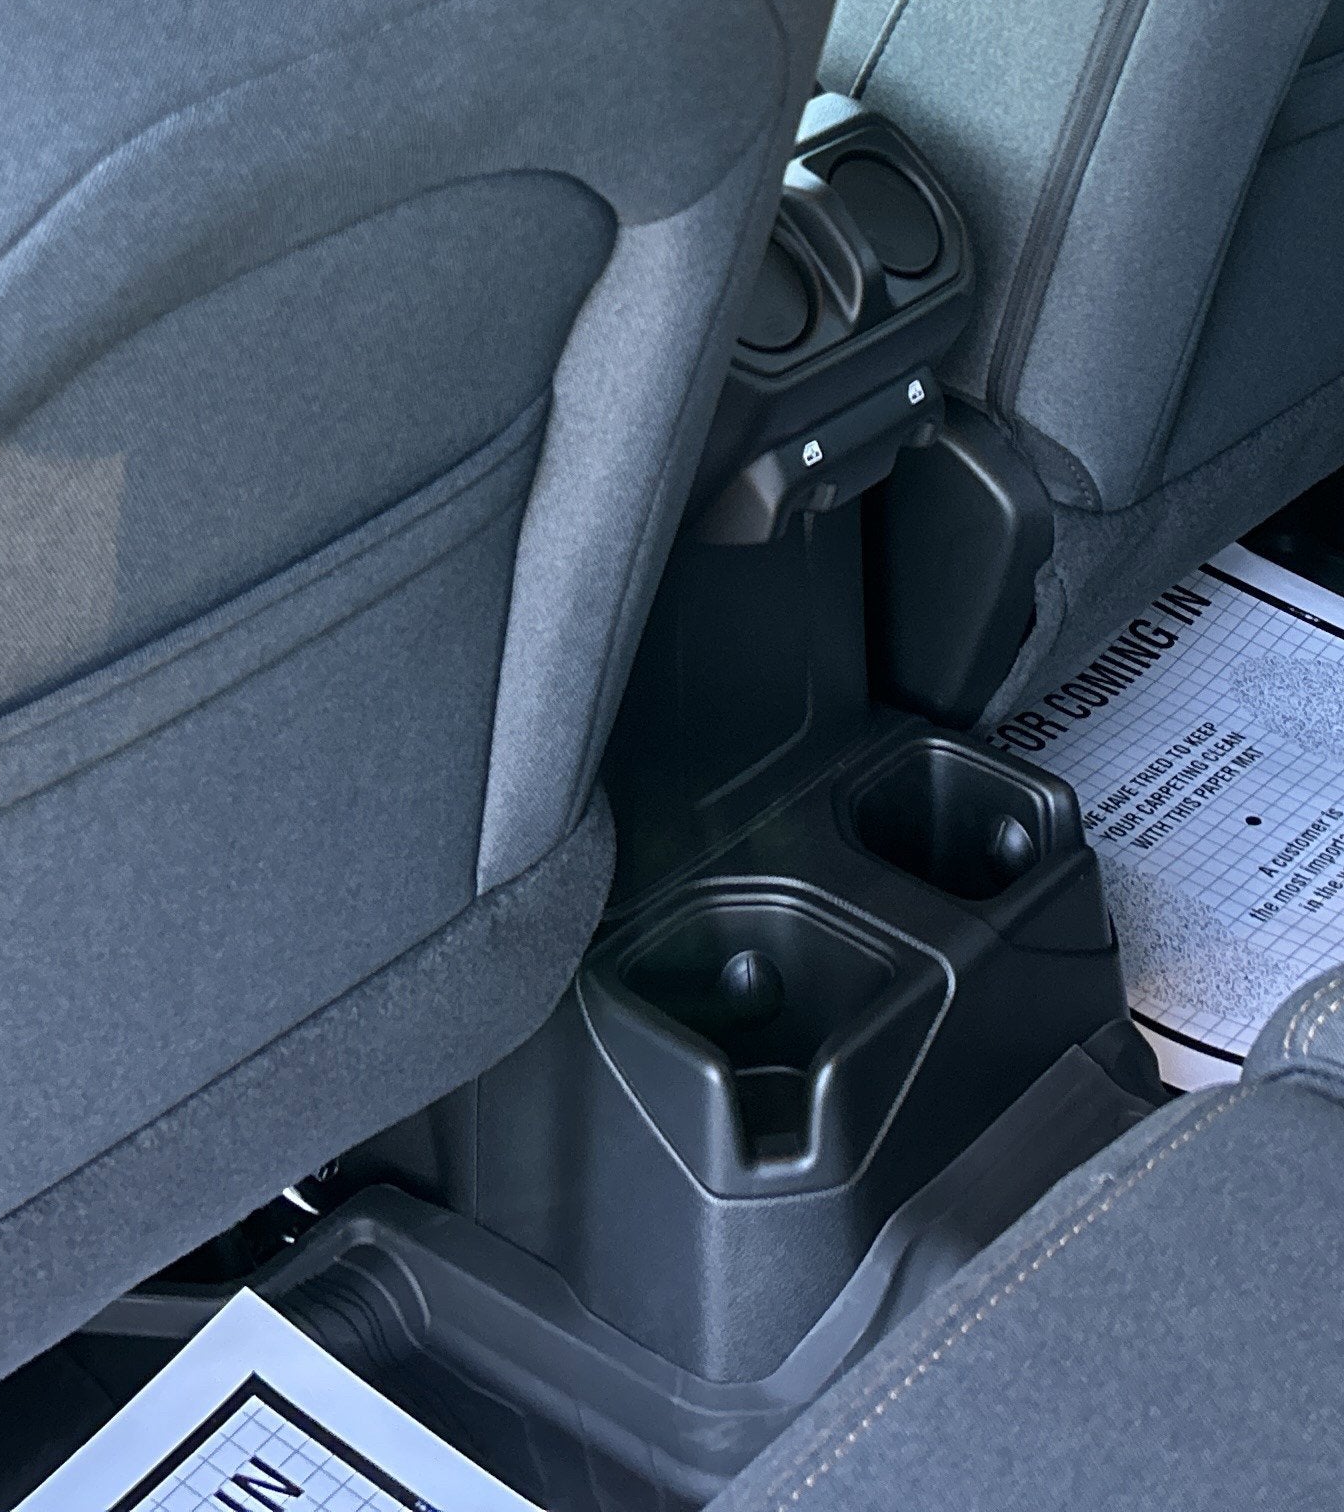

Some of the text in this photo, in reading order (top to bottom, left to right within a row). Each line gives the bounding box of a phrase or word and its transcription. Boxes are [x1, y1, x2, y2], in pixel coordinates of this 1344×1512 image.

[1043, 618, 1179, 719] COMING
[1151, 585, 1212, 626] IN
[1097, 784, 1139, 814] HAVE
[1129, 757, 1174, 787] TRIED
[1165, 744, 1191, 759] TO
[1183, 722, 1218, 747] KEEP
[1099, 731, 1247, 842] YOUR CARPETING CLEAN
[1130, 746, 1264, 849] WITH THIS PAPER MAT
[1258, 808, 1344, 879] A customer is
[1248, 901, 1280, 923] the
[1273, 872, 1313, 904] most
[1298, 899, 1324, 913] in
[1313, 880, 1344, 900] the
